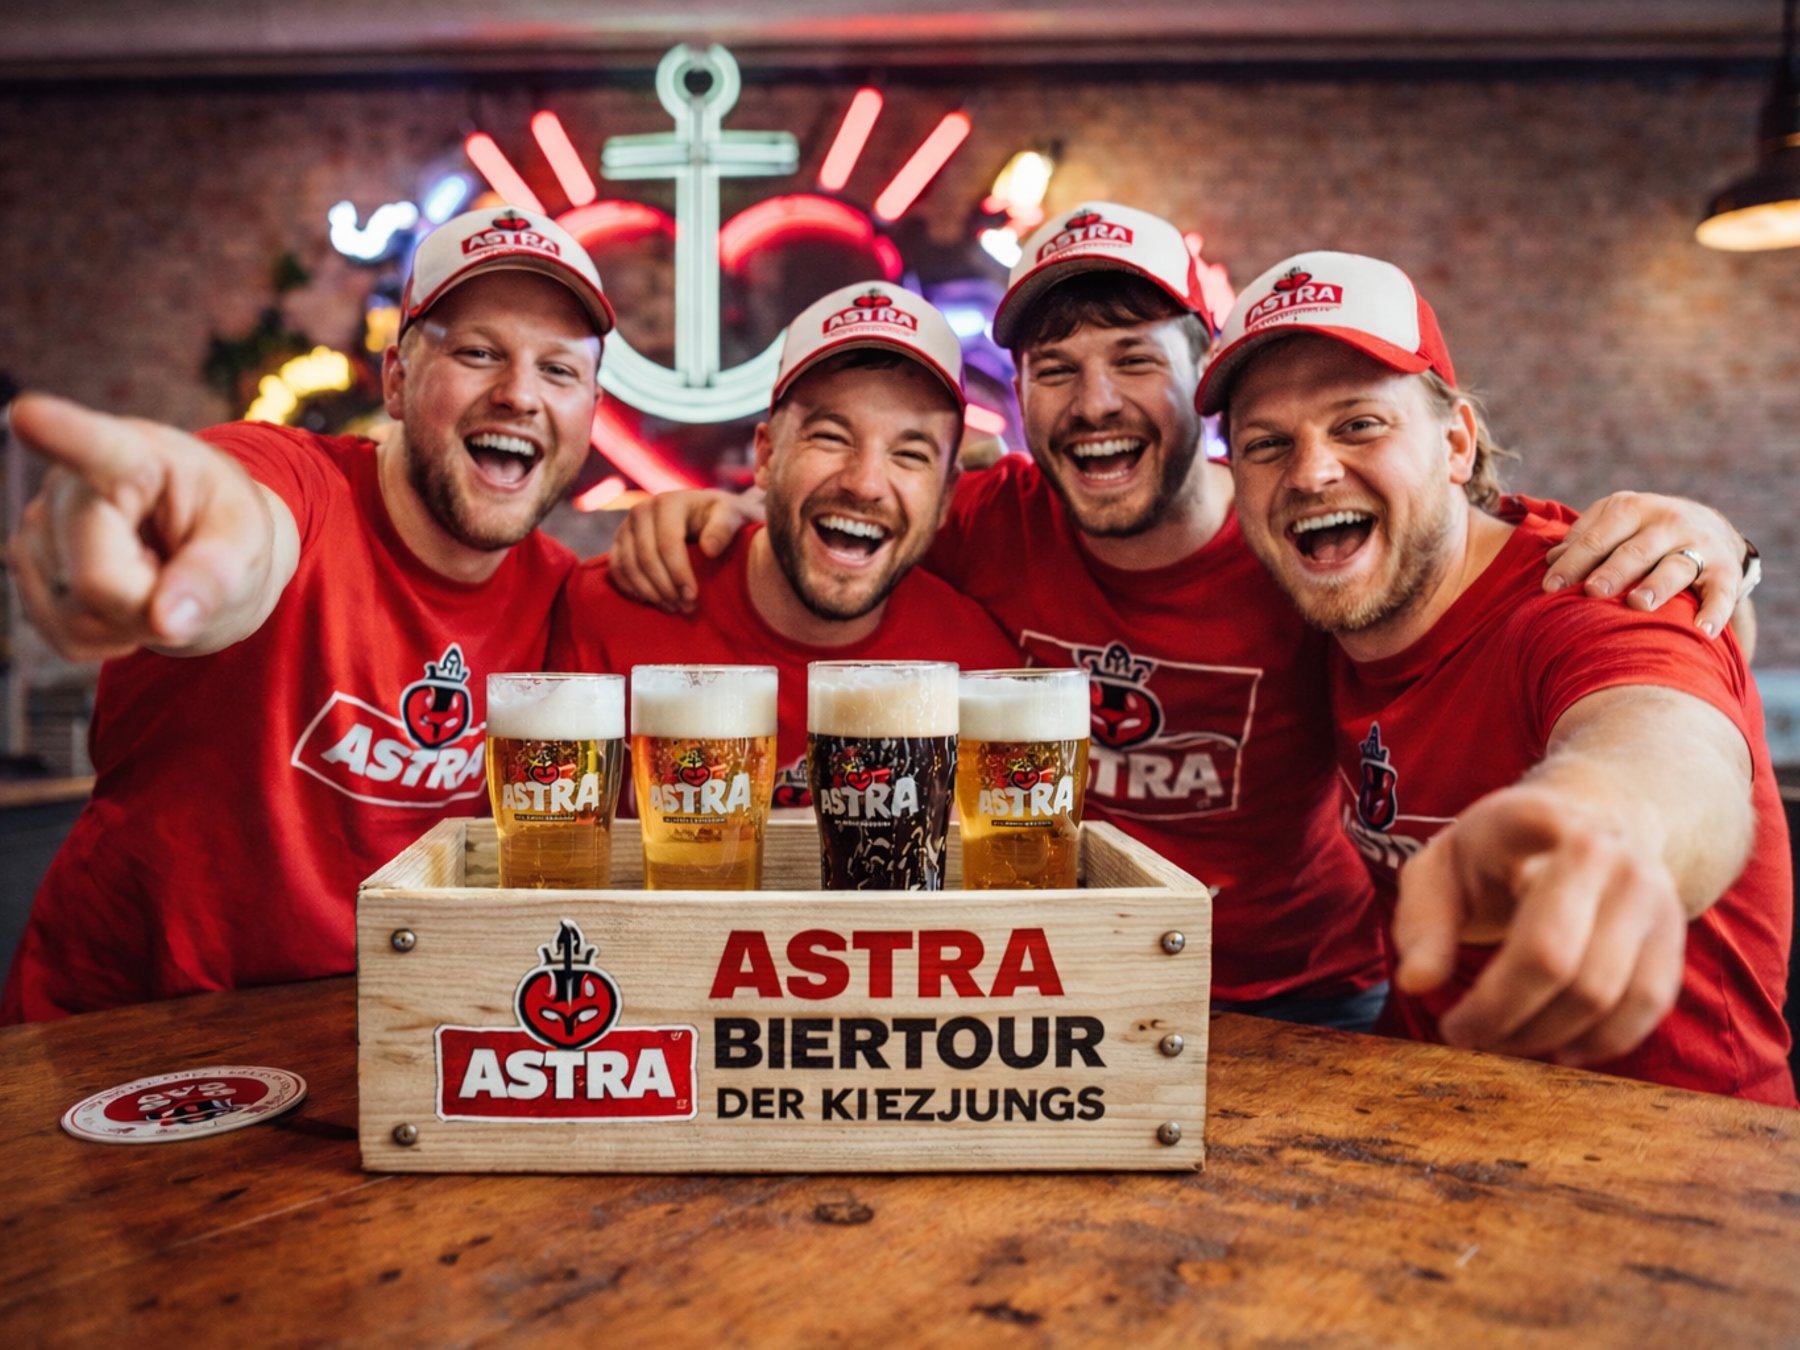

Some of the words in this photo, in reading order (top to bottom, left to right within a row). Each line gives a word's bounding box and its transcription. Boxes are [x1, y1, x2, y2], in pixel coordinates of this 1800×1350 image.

[468, 230, 557, 254] ASTRA
[828, 307, 914, 331] ASTRA
[1250, 285, 1336, 323] ASTRA
[321, 723, 485, 790] ASTRA
[1087, 751, 1224, 799] TRA
[502, 772, 599, 812] ASTRA
[651, 772, 752, 814] ASTRA
[821, 776, 919, 818] ASTRA
[978, 775, 1074, 817] ASTRA
[708, 928, 1065, 1000] ASTRA
[714, 1016, 1107, 1070] BIERTOUR
[458, 1049, 677, 1100] ASTRA
[717, 1087, 805, 1120] DER
[821, 1086, 1106, 1122] KIEZJUNGS
